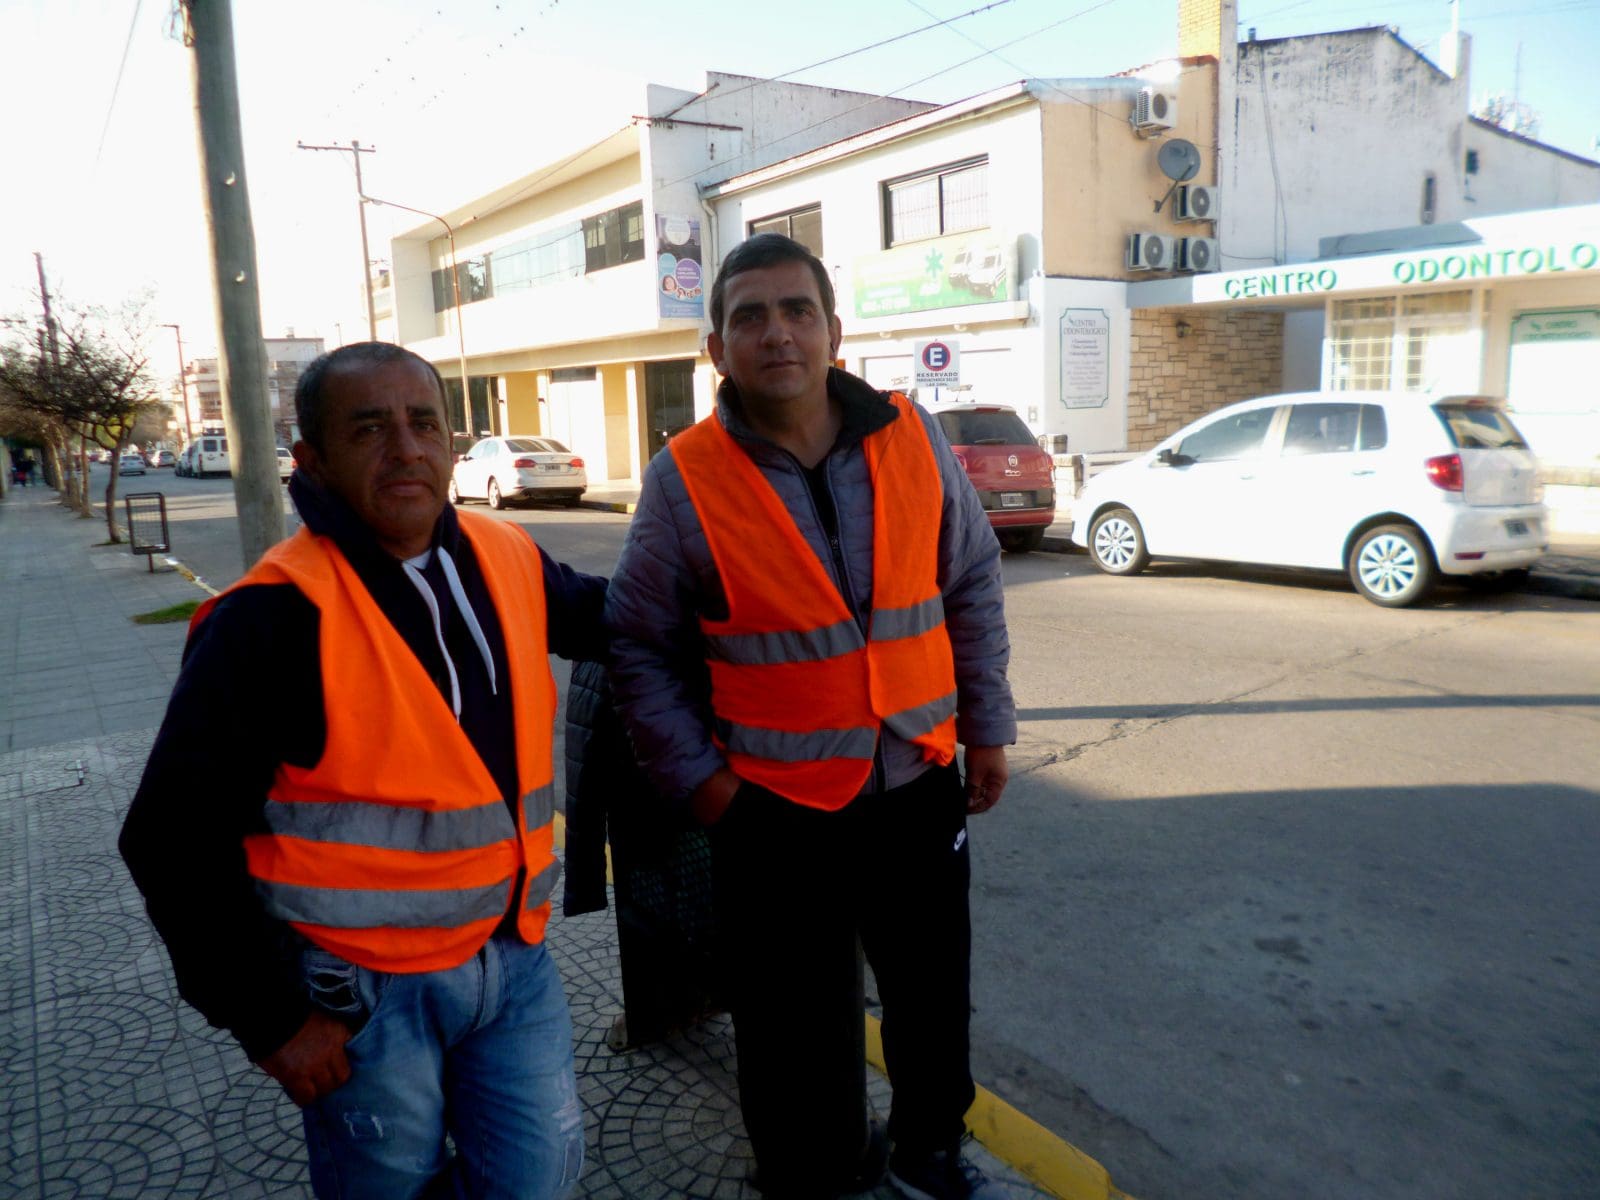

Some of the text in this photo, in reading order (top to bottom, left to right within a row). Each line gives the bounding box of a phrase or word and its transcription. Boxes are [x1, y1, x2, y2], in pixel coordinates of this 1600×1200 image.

[1224, 243, 1598, 299] CENTRO ODONTOLO
[929, 347, 943, 366] E
